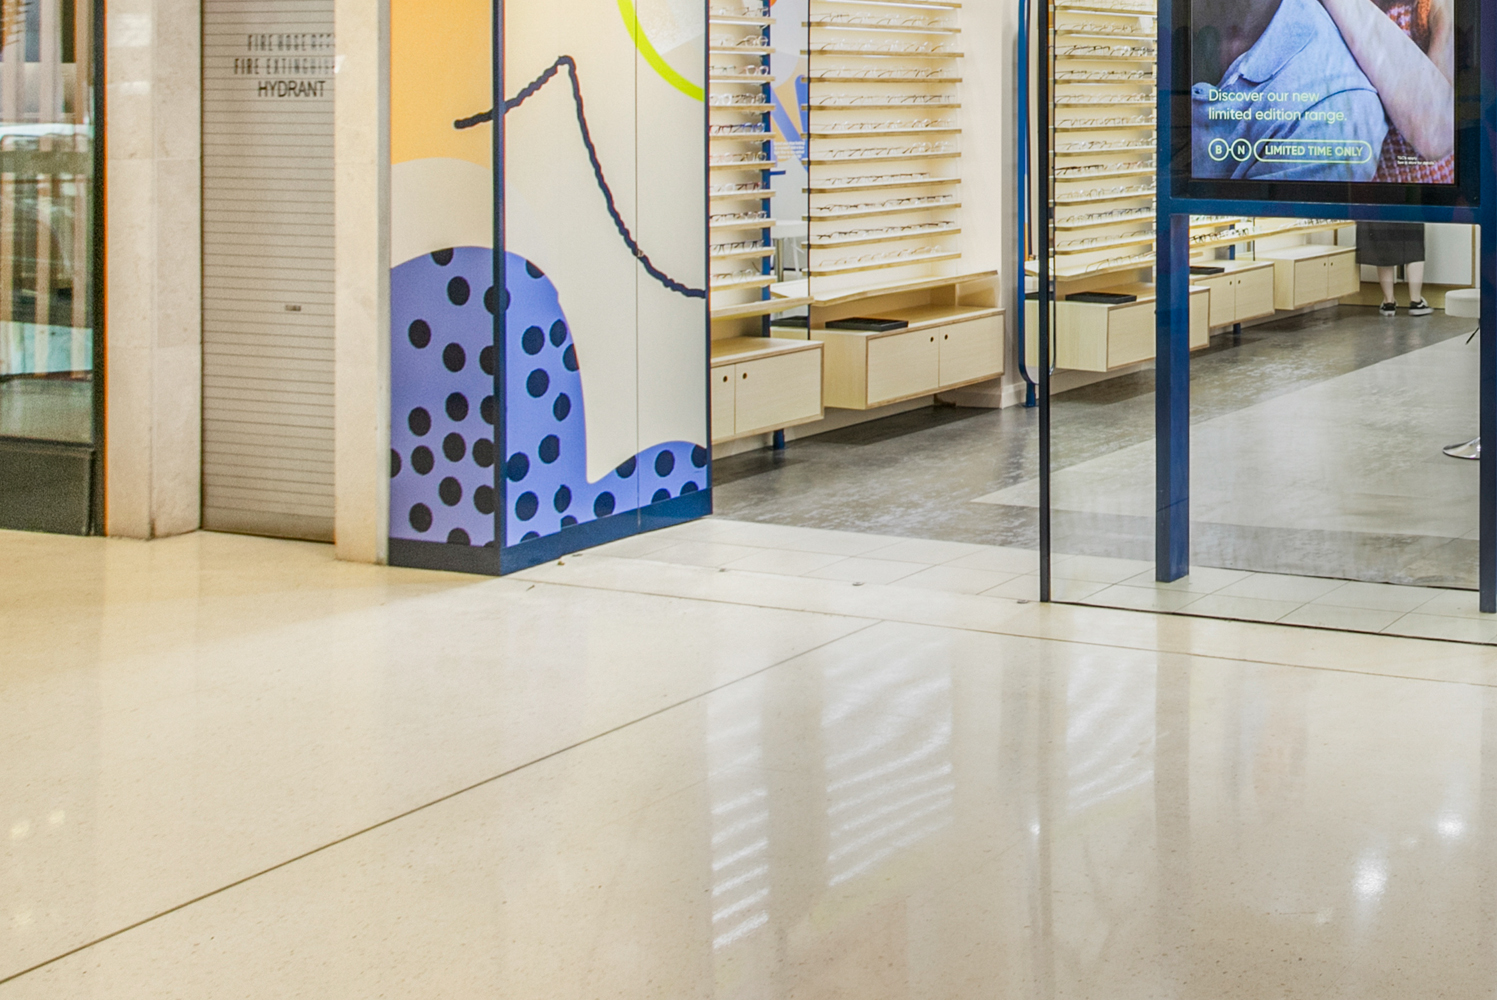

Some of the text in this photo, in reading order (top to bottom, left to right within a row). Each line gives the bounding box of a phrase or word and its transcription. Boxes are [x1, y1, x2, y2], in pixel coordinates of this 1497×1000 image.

[234, 58, 260, 75] FIRE
[257, 80, 326, 98] HYDRANT
[1208, 88, 1320, 102] Discover our new
[1208, 107, 1348, 125] limited edition range.
[1265, 145, 1306, 156] LIMITED
[1308, 146, 1332, 156] TIME
[1335, 146, 1364, 157] ONLY
